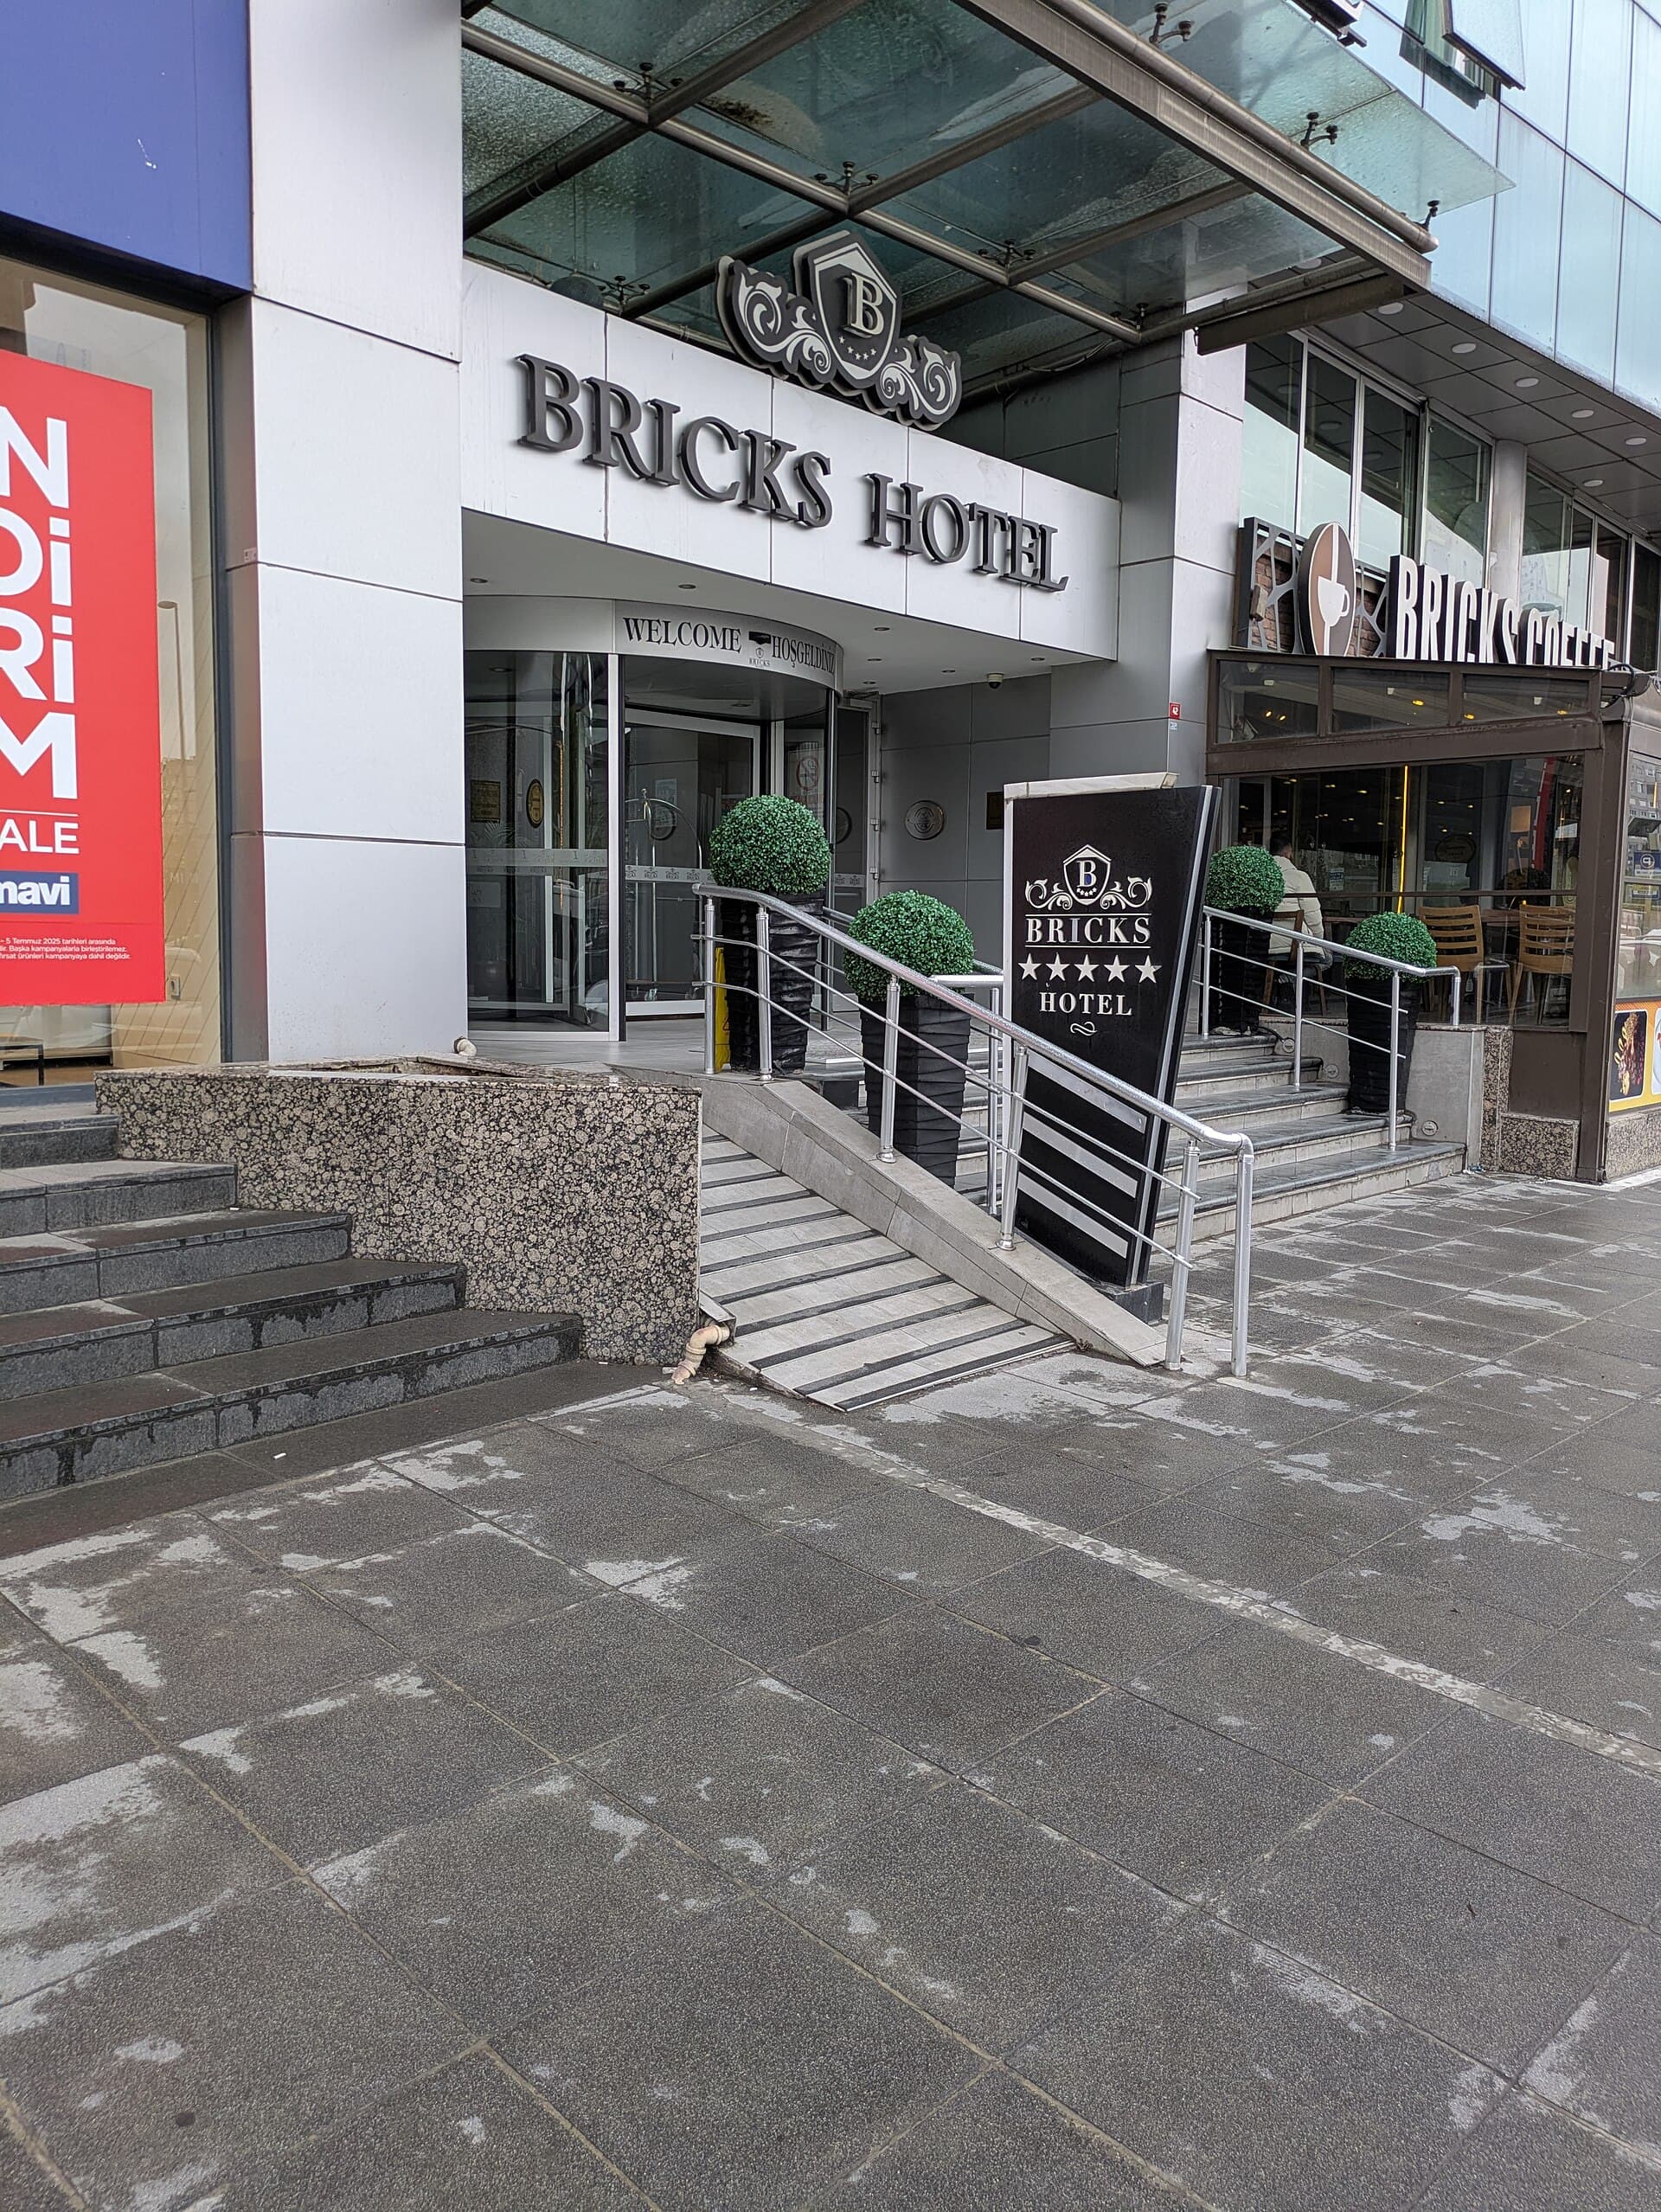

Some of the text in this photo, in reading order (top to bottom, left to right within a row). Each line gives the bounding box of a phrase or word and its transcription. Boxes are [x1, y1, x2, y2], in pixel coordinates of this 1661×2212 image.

[843, 271, 885, 338] B
[516, 354, 1068, 593] BRICKS HOTEL
[1391, 553, 1518, 664] BRICKS
[623, 617, 742, 654] WELCOME
[1078, 860, 1098, 888] B
[1025, 917, 1151, 945] BRICKS
[31, 945, 80, 953] kampanyalarla
[1039, 991, 1132, 1016] HOTEL
